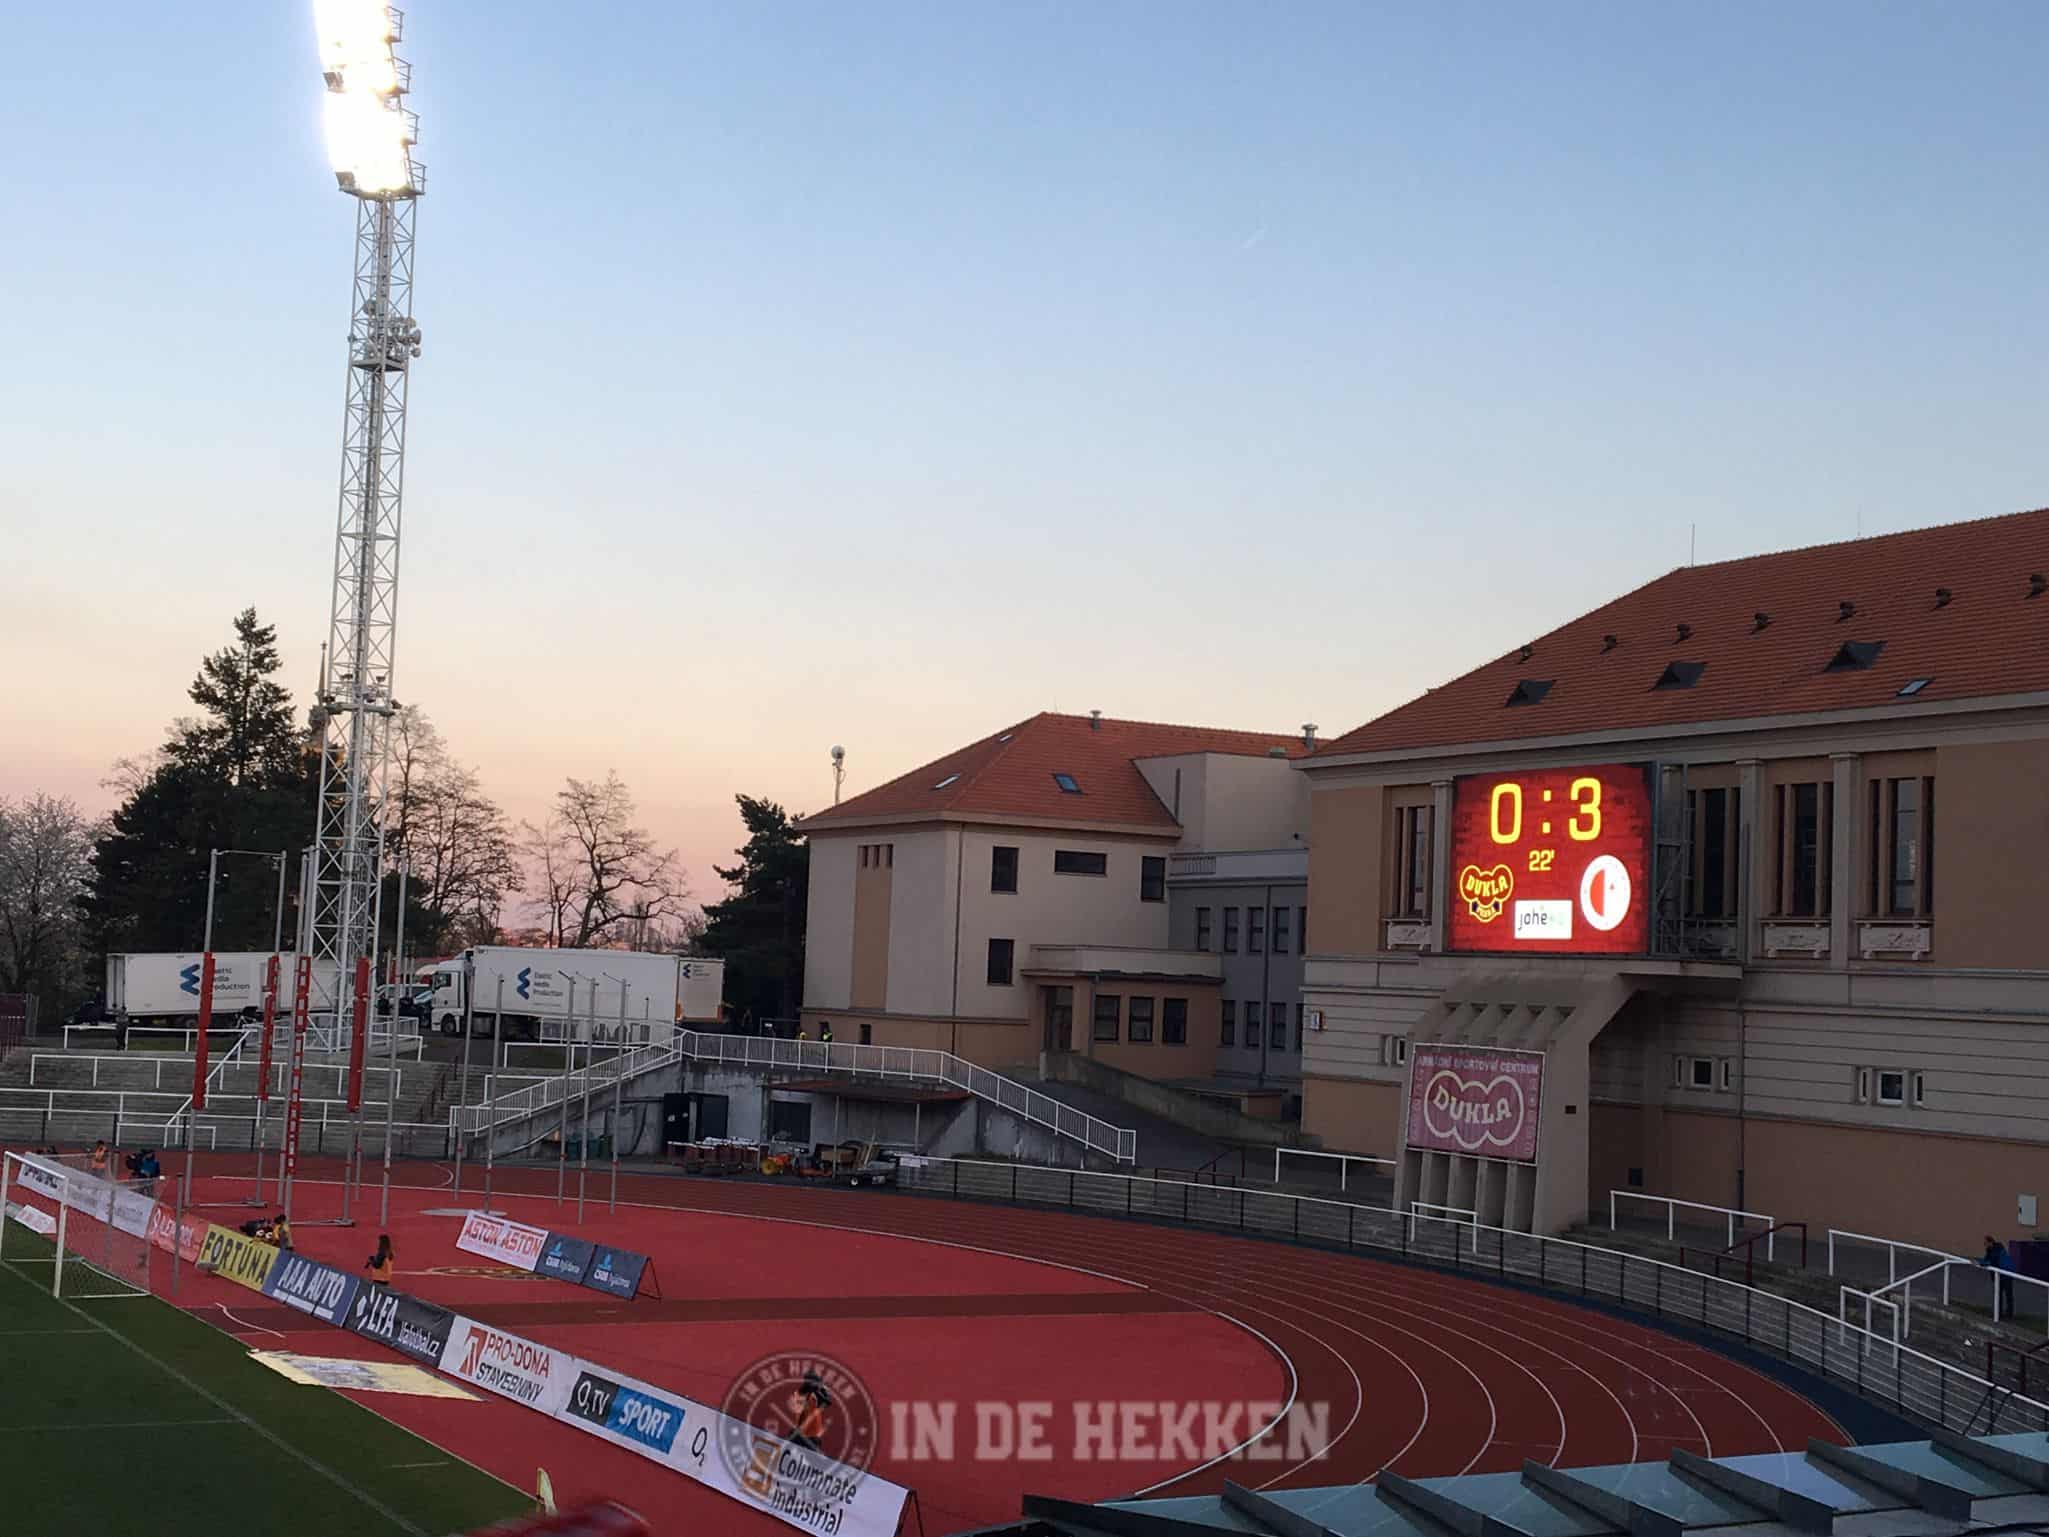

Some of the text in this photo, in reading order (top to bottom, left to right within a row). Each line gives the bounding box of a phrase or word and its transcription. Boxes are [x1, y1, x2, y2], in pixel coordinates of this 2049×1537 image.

[1490, 783, 1522, 844] 0
[1568, 777, 1601, 841] 3
[1465, 875, 1509, 897] DUKLA
[1433, 1085, 1512, 1124] DUKLA
[201, 1231, 272, 1284] FORTUNA
[501, 1232, 543, 1258] ASTON
[277, 1256, 346, 1308] AAA AUTO
[368, 1293, 400, 1338] LFA
[486, 1333, 550, 1378] PRO-DOMA
[476, 1362, 544, 1402] STAVEBNINY
[618, 1398, 671, 1439] SPORT
